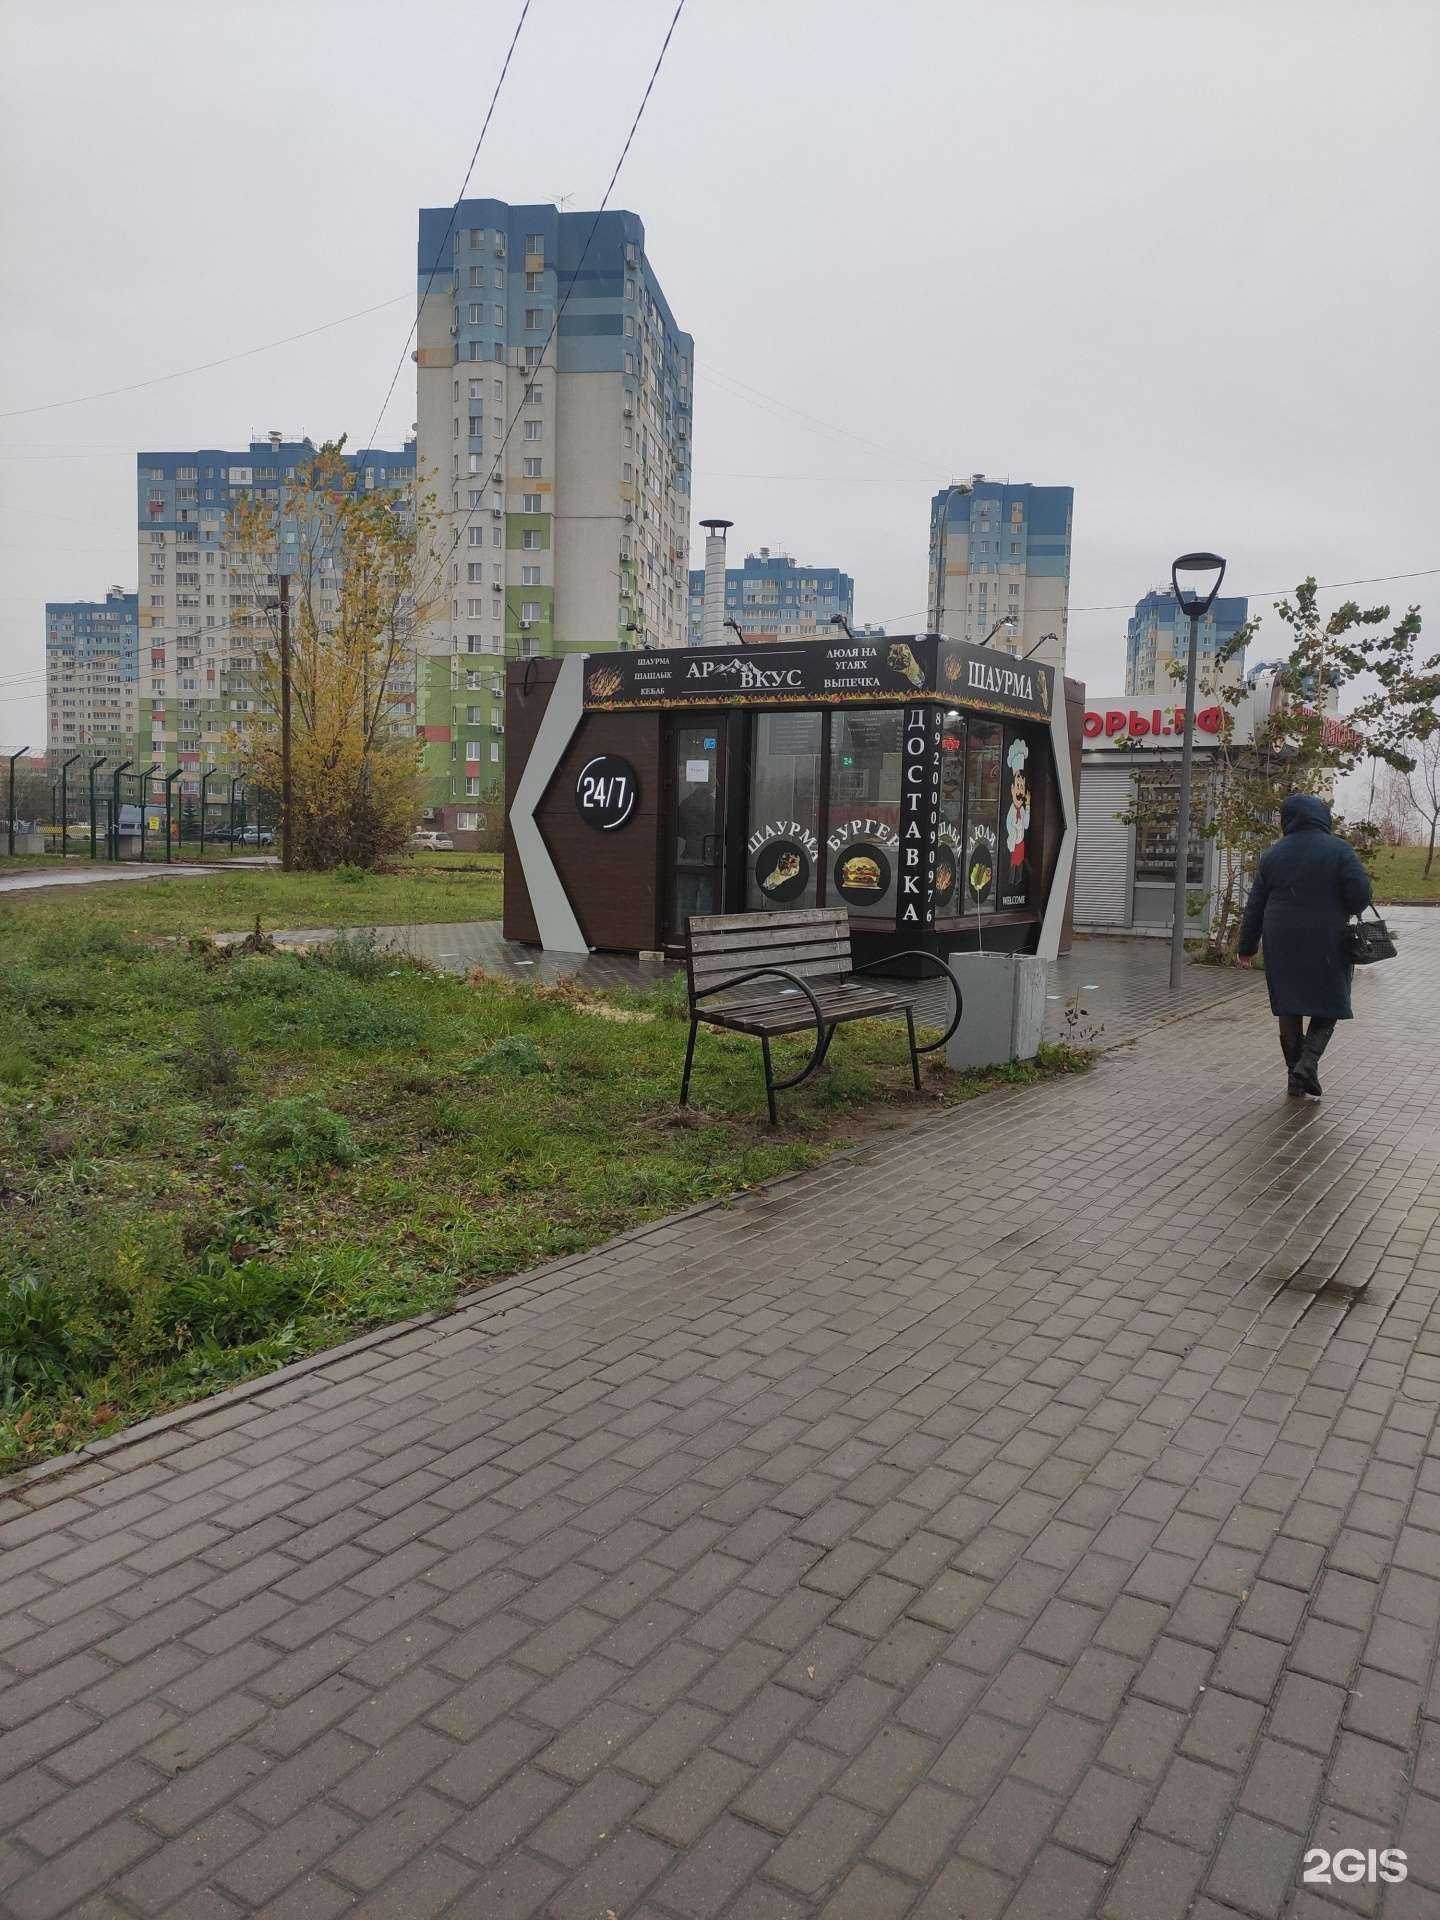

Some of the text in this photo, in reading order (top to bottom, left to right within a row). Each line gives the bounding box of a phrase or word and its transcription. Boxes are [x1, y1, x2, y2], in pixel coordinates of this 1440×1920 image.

[826, 647, 878, 658] ЛЮЛЯ НА
[637, 657, 670, 666] ШАУРМА
[835, 660, 868, 670] УГЛЯХ
[634, 671, 672, 680] ШАШЛЫК
[740, 669, 802, 688] ВКУС
[824, 677, 880, 688] ВЫПЕЧКА
[967, 661, 1033, 700] ШАУРМА
[583, 776, 627, 809] 24/7
[902, 709, 926, 922] ДОСТАВКА
[926, 711, 941, 923] 89200090976
[747, 820, 818, 863] ШАУРМА
[1002, 895, 1026, 905] WELCOME
